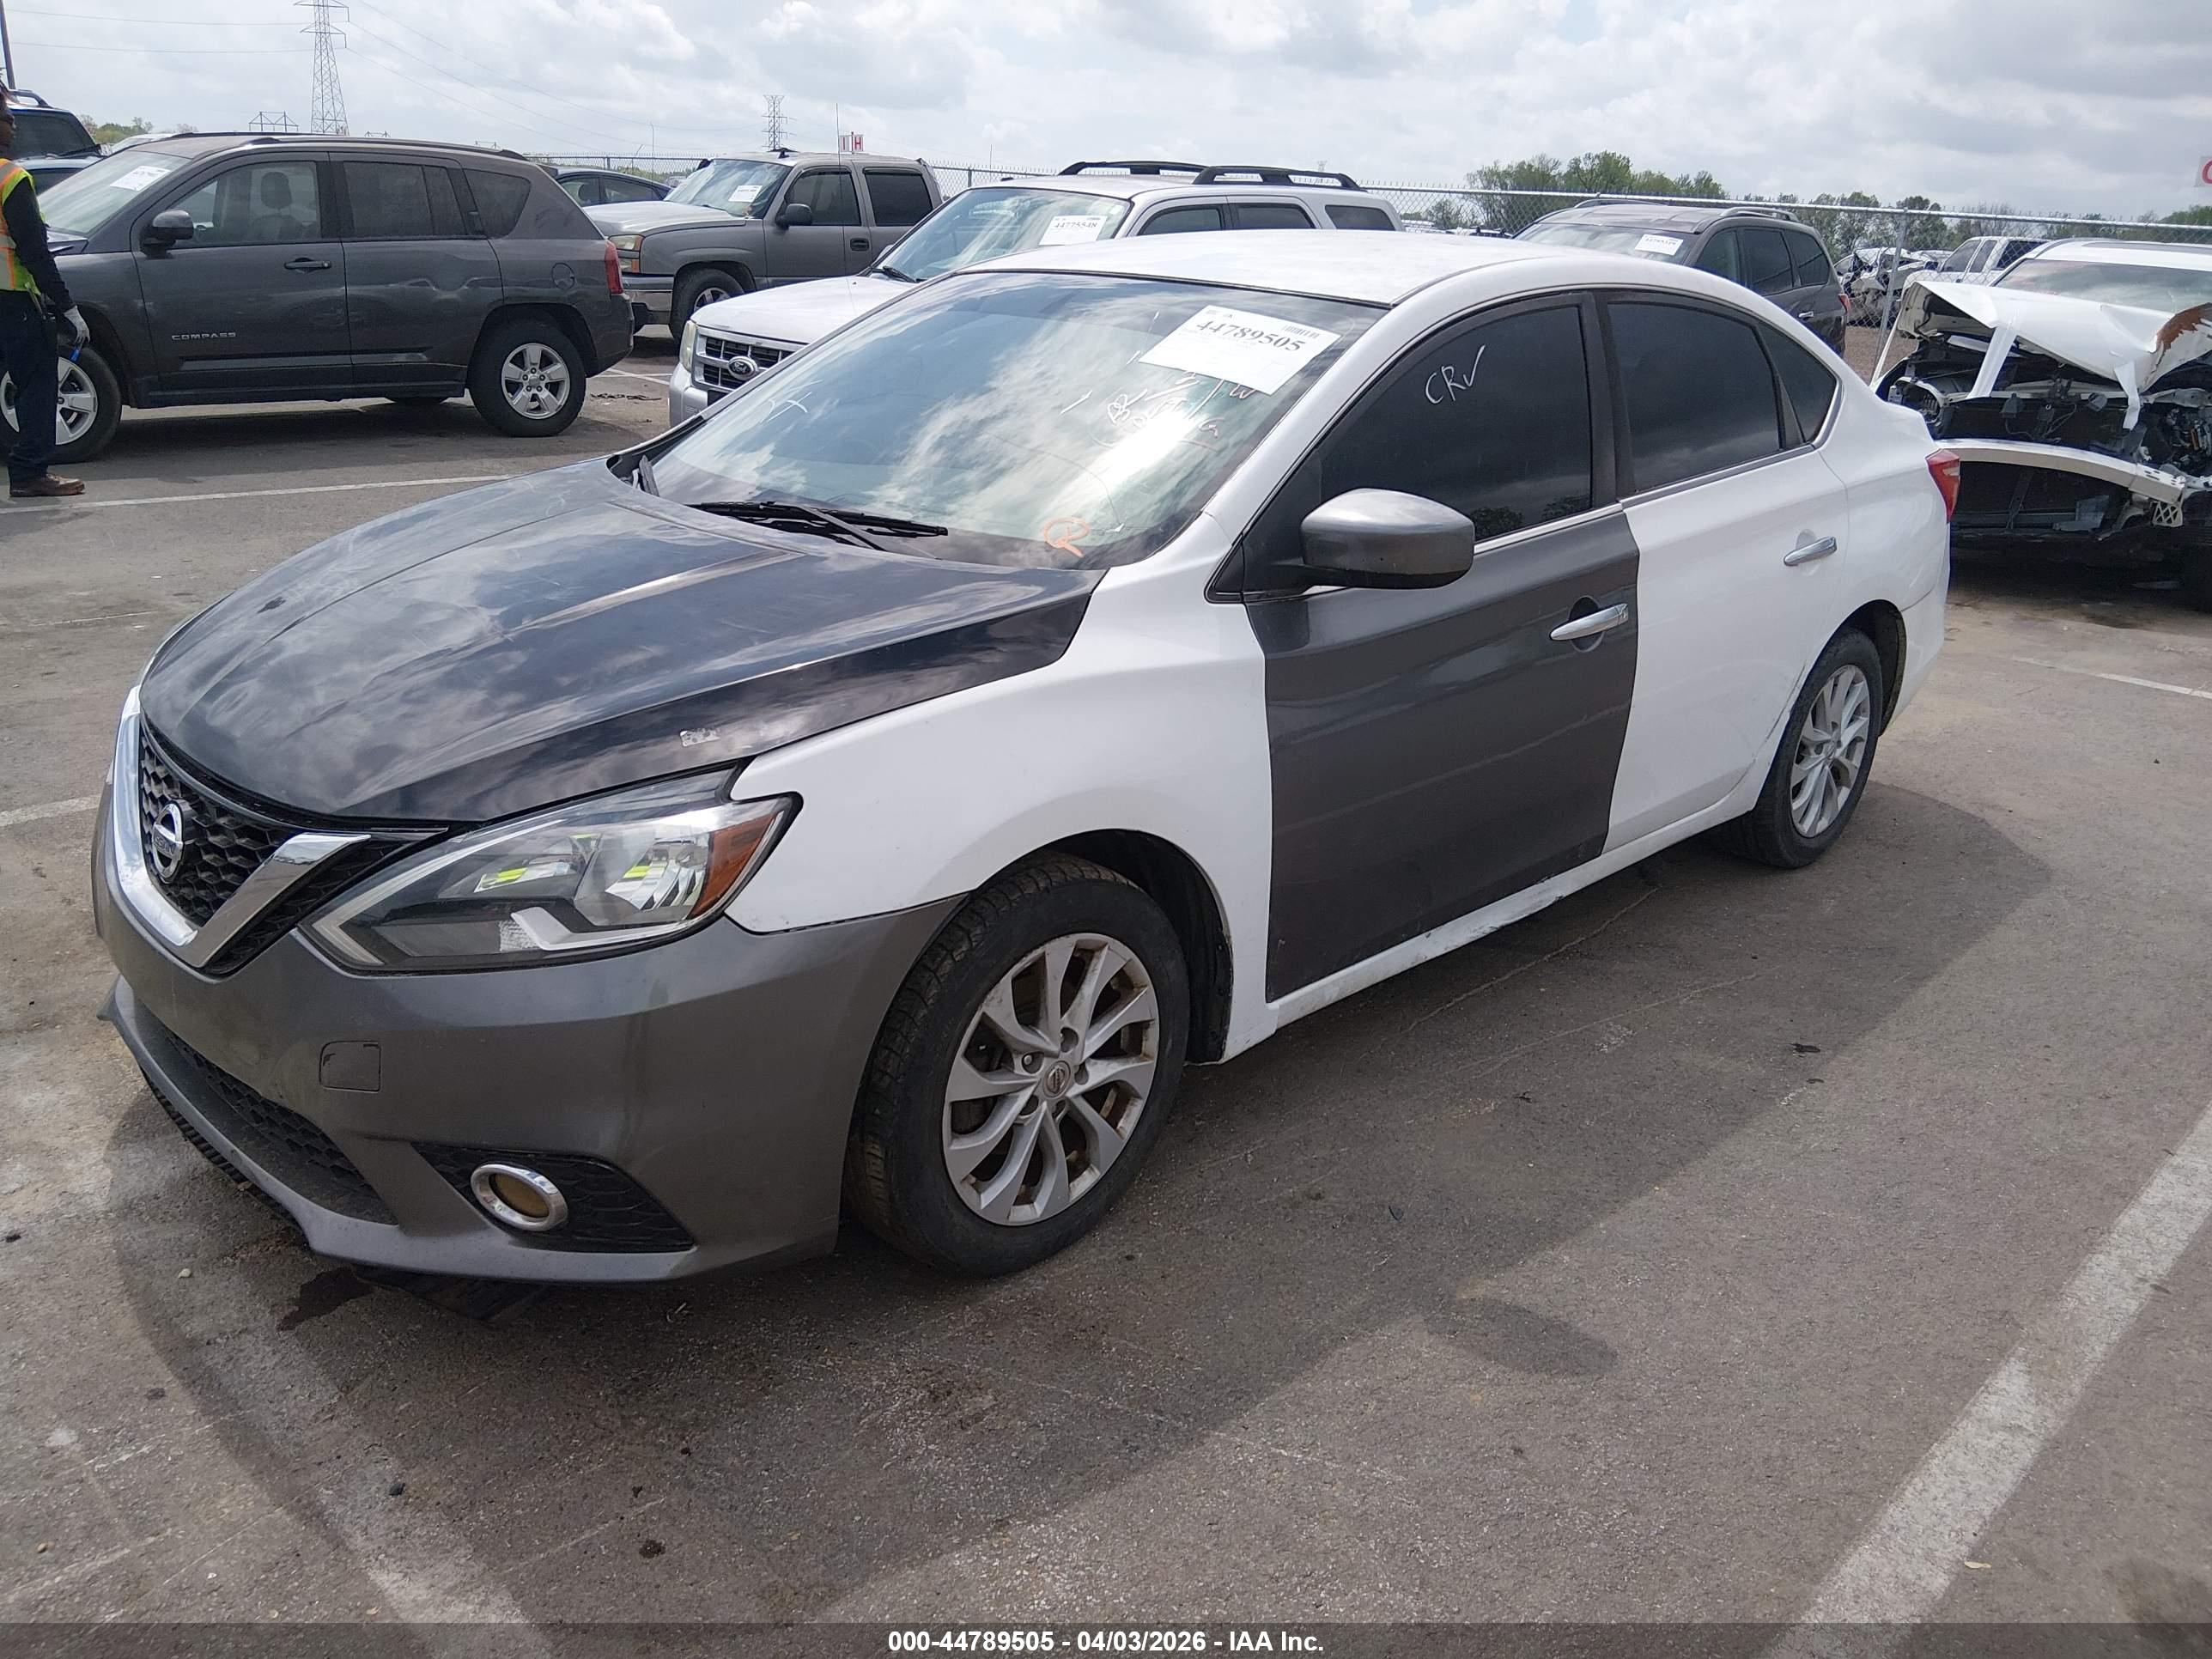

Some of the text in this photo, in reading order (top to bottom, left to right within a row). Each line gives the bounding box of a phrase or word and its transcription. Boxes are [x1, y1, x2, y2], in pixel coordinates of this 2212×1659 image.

[854, 137, 862, 150] H
[171, 331, 237, 341] COMPASS
[1196, 320, 1307, 352] 44789505
